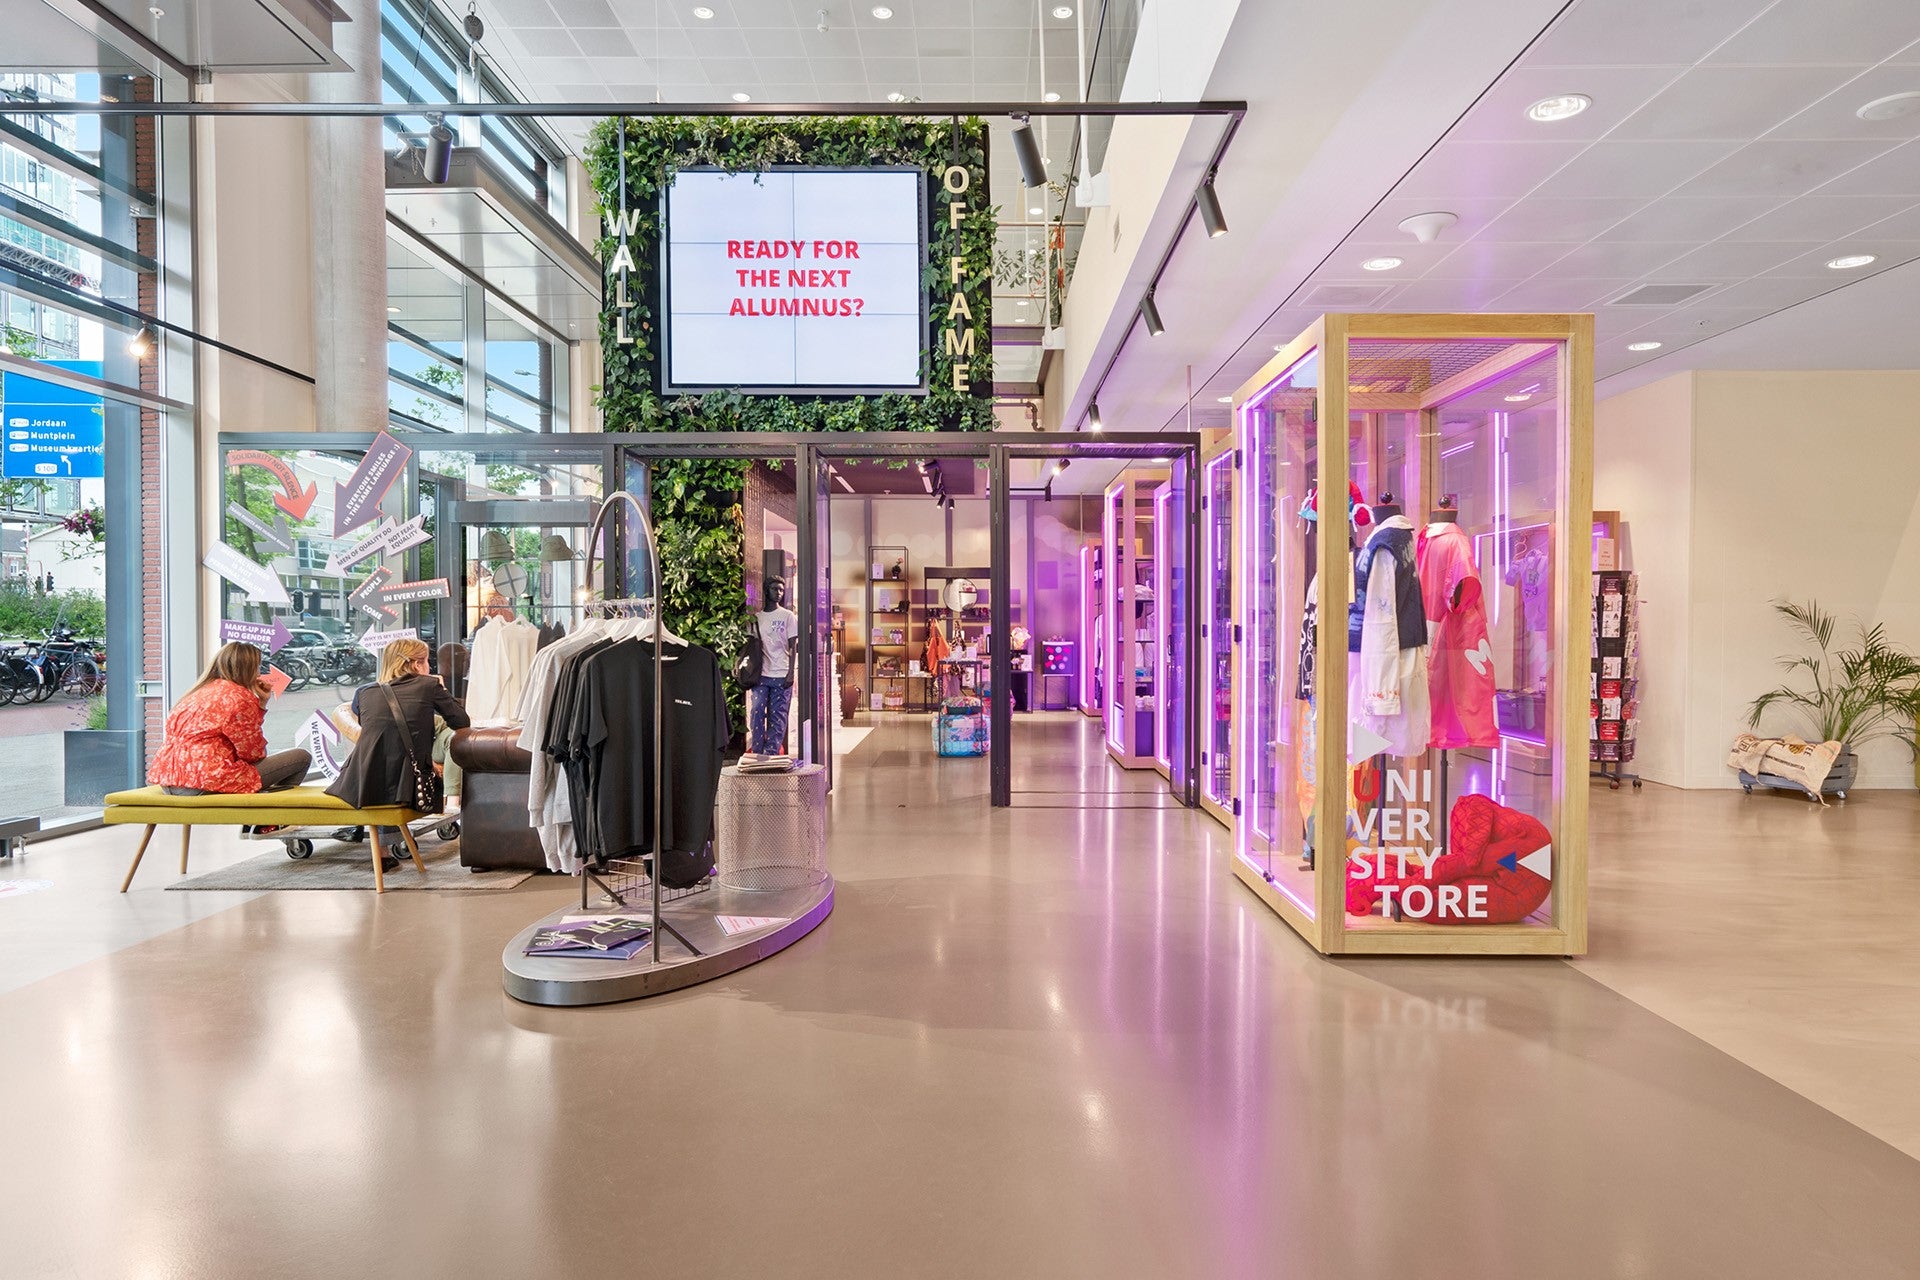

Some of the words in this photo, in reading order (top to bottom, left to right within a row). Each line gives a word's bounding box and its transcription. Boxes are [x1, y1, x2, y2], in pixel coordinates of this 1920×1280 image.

[944, 165, 970, 230] OF
[727, 240, 805, 259] READY
[813, 239, 860, 259] FOR
[606, 208, 639, 344] WALL
[736, 269, 780, 288] THE
[788, 269, 851, 288] NEXT
[729, 298, 865, 317] ALUMNUS?
[945, 256, 975, 391] FAME
[31, 419, 67, 427] Jordaan
[30, 431, 76, 440] Muntplein
[232, 452, 272, 462] SOLIDARITY
[271, 460, 285, 472] NOT
[283, 471, 299, 499] SILENCE
[346, 477, 371, 510] EVERYONE
[368, 452, 386, 476] SMILES
[343, 516, 352, 526] IN
[349, 503, 361, 518] THE
[357, 485, 373, 504] SAME
[370, 450, 396, 486] LANGUAGE
[388, 533, 401, 544] NOT
[400, 524, 415, 535] FEAR
[391, 529, 418, 549] EQUALITY
[337, 556, 350, 566] MEN
[350, 550, 359, 558] OF
[359, 534, 382, 553] QUALITY
[382, 528, 392, 537] DO
[360, 576, 382, 599] PEOPLE
[383, 594, 392, 602] IN
[393, 592, 416, 601] EVERY
[417, 588, 442, 598] COLOR
[362, 604, 383, 620] COME
[224, 623, 259, 633] MAKE-UP
[260, 628, 276, 636] HAS
[241, 633, 271, 642] GENDER
[311, 720, 319, 736] WE
[313, 735, 325, 764] WRITE
[320, 764, 335, 779] THE
[1353, 769, 1431, 802] UNI
[1350, 808, 1433, 841] VER
[1350, 846, 1443, 880] SITY
